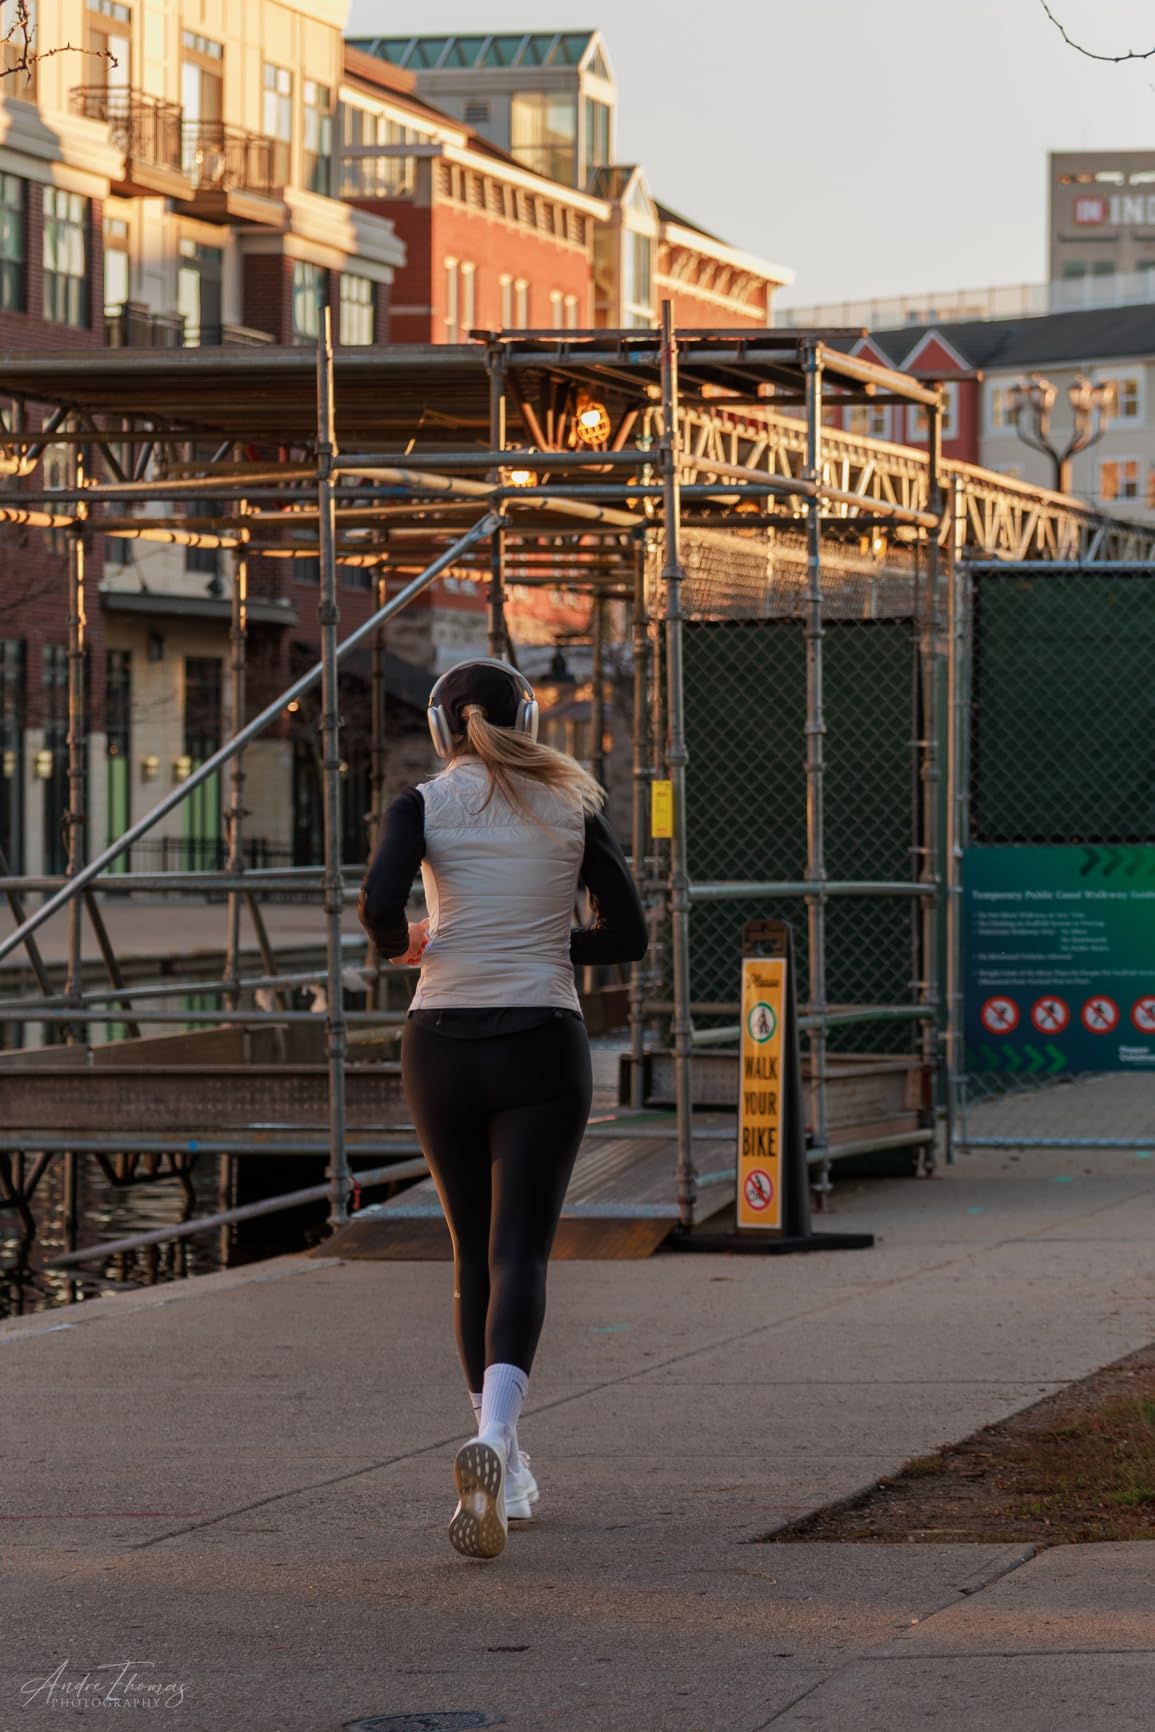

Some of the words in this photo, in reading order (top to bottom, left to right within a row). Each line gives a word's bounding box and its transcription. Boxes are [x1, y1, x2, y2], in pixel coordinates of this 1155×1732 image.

[744, 1056, 778, 1080] WALK
[744, 1091, 777, 1116] YOUR
[743, 1127, 776, 1157] BIKE
